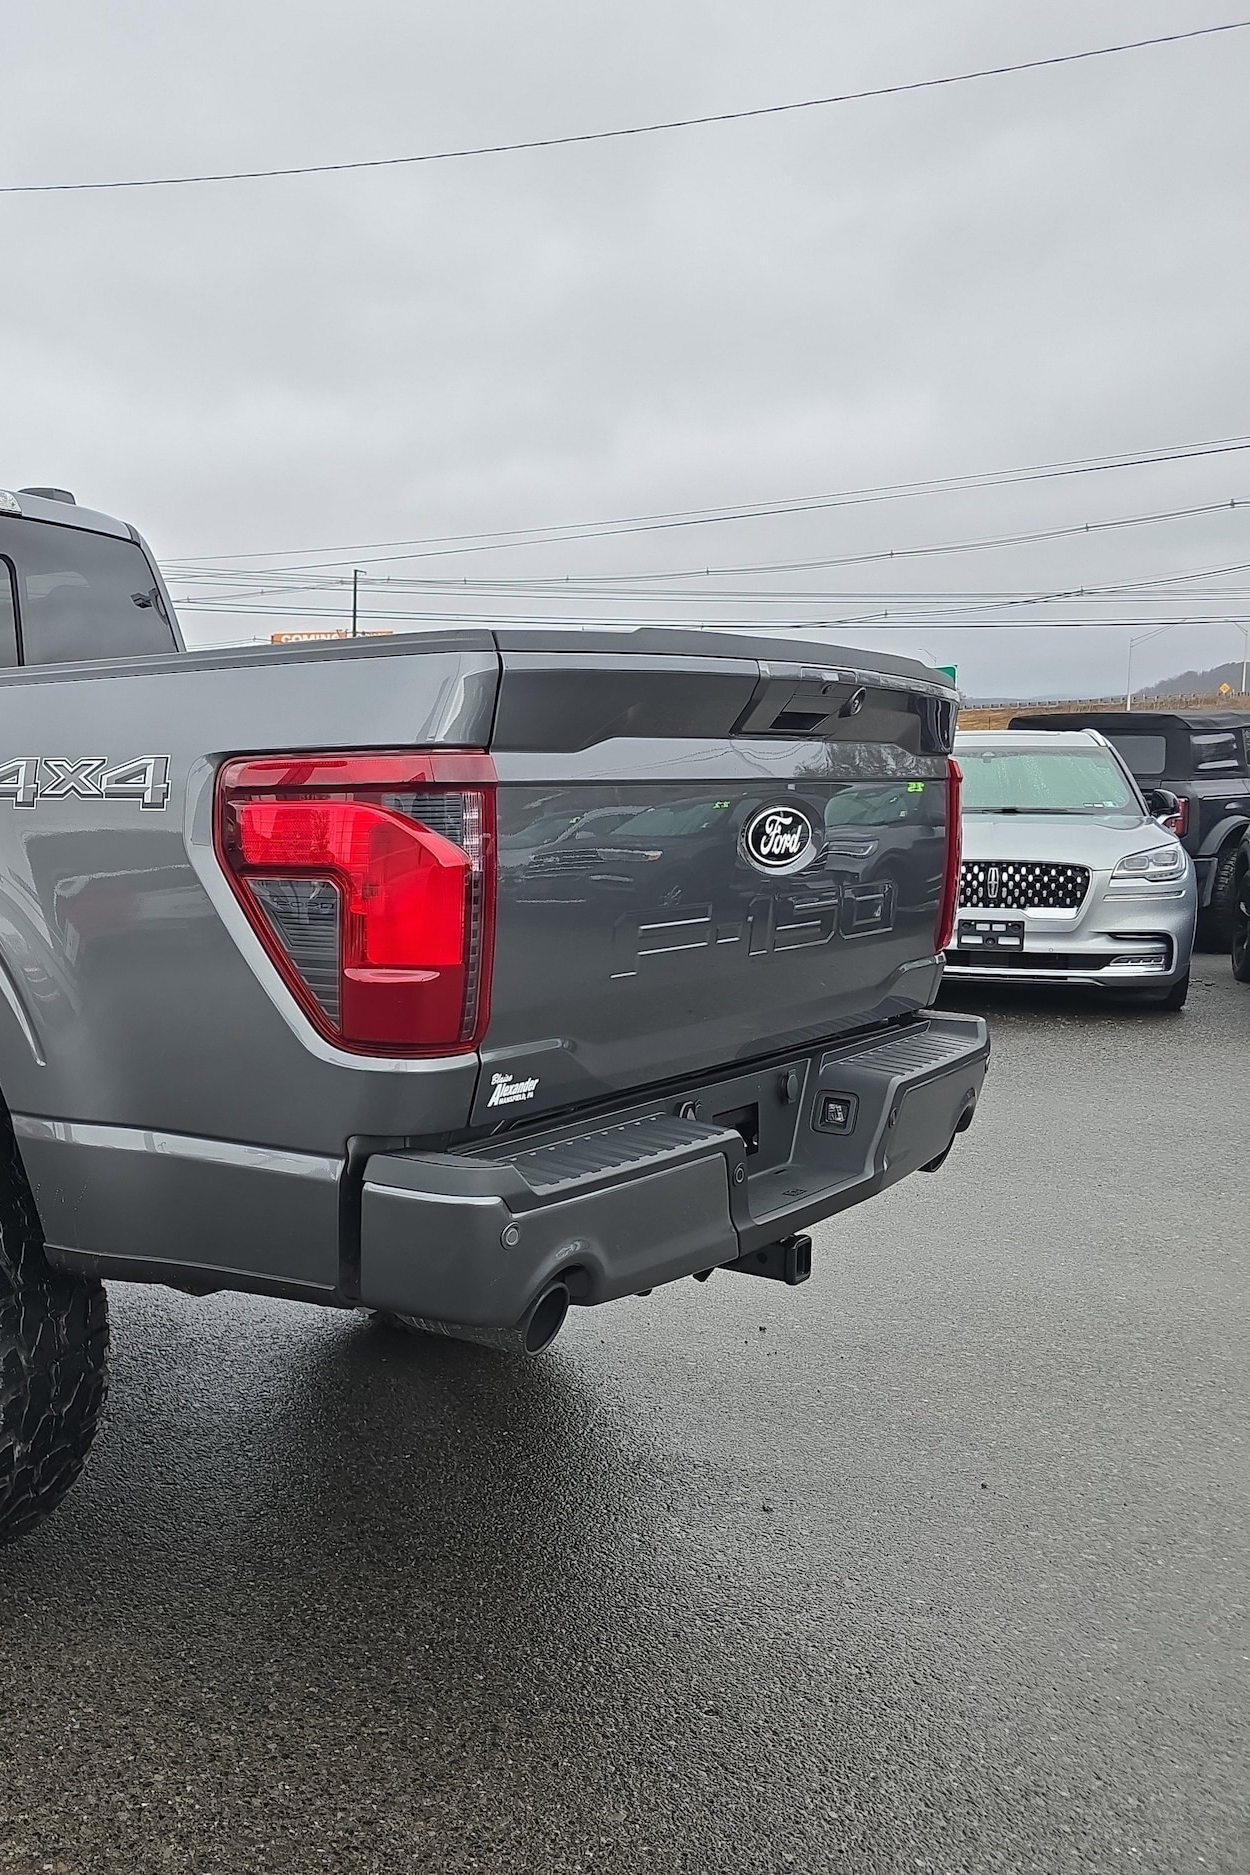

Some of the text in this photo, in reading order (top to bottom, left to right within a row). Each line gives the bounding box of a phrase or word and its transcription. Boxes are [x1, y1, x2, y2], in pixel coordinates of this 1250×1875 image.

[760, 815, 803, 855] Ford
[610, 879, 898, 979] F-150
[487, 1077, 539, 1107] Alexander
